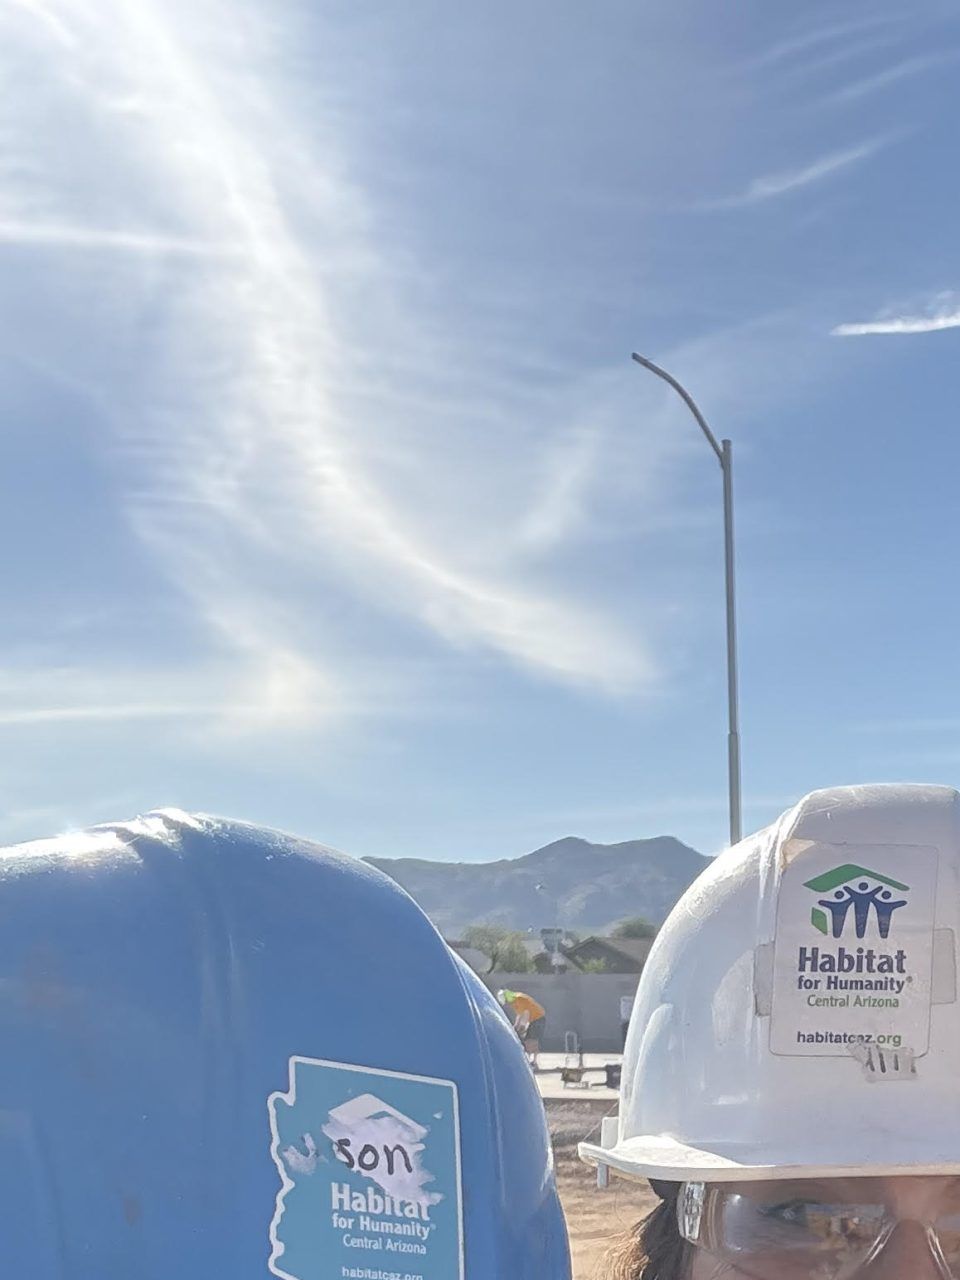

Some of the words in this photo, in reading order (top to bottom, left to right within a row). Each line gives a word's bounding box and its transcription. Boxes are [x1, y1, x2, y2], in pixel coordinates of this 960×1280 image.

[797, 947, 907, 974] Habitat
[797, 975, 822, 990] for
[826, 976, 905, 994] Humanity
[807, 994, 850, 1008] Central
[853, 995, 900, 1008] Arizona
[796, 1031, 902, 1047] habitatcaz.org
[331, 1182, 431, 1222] Habitat
[332, 1214, 354, 1229] for
[359, 1216, 431, 1240] Humanity
[343, 1234, 383, 1251] Central
[386, 1240, 427, 1256] Arizona
